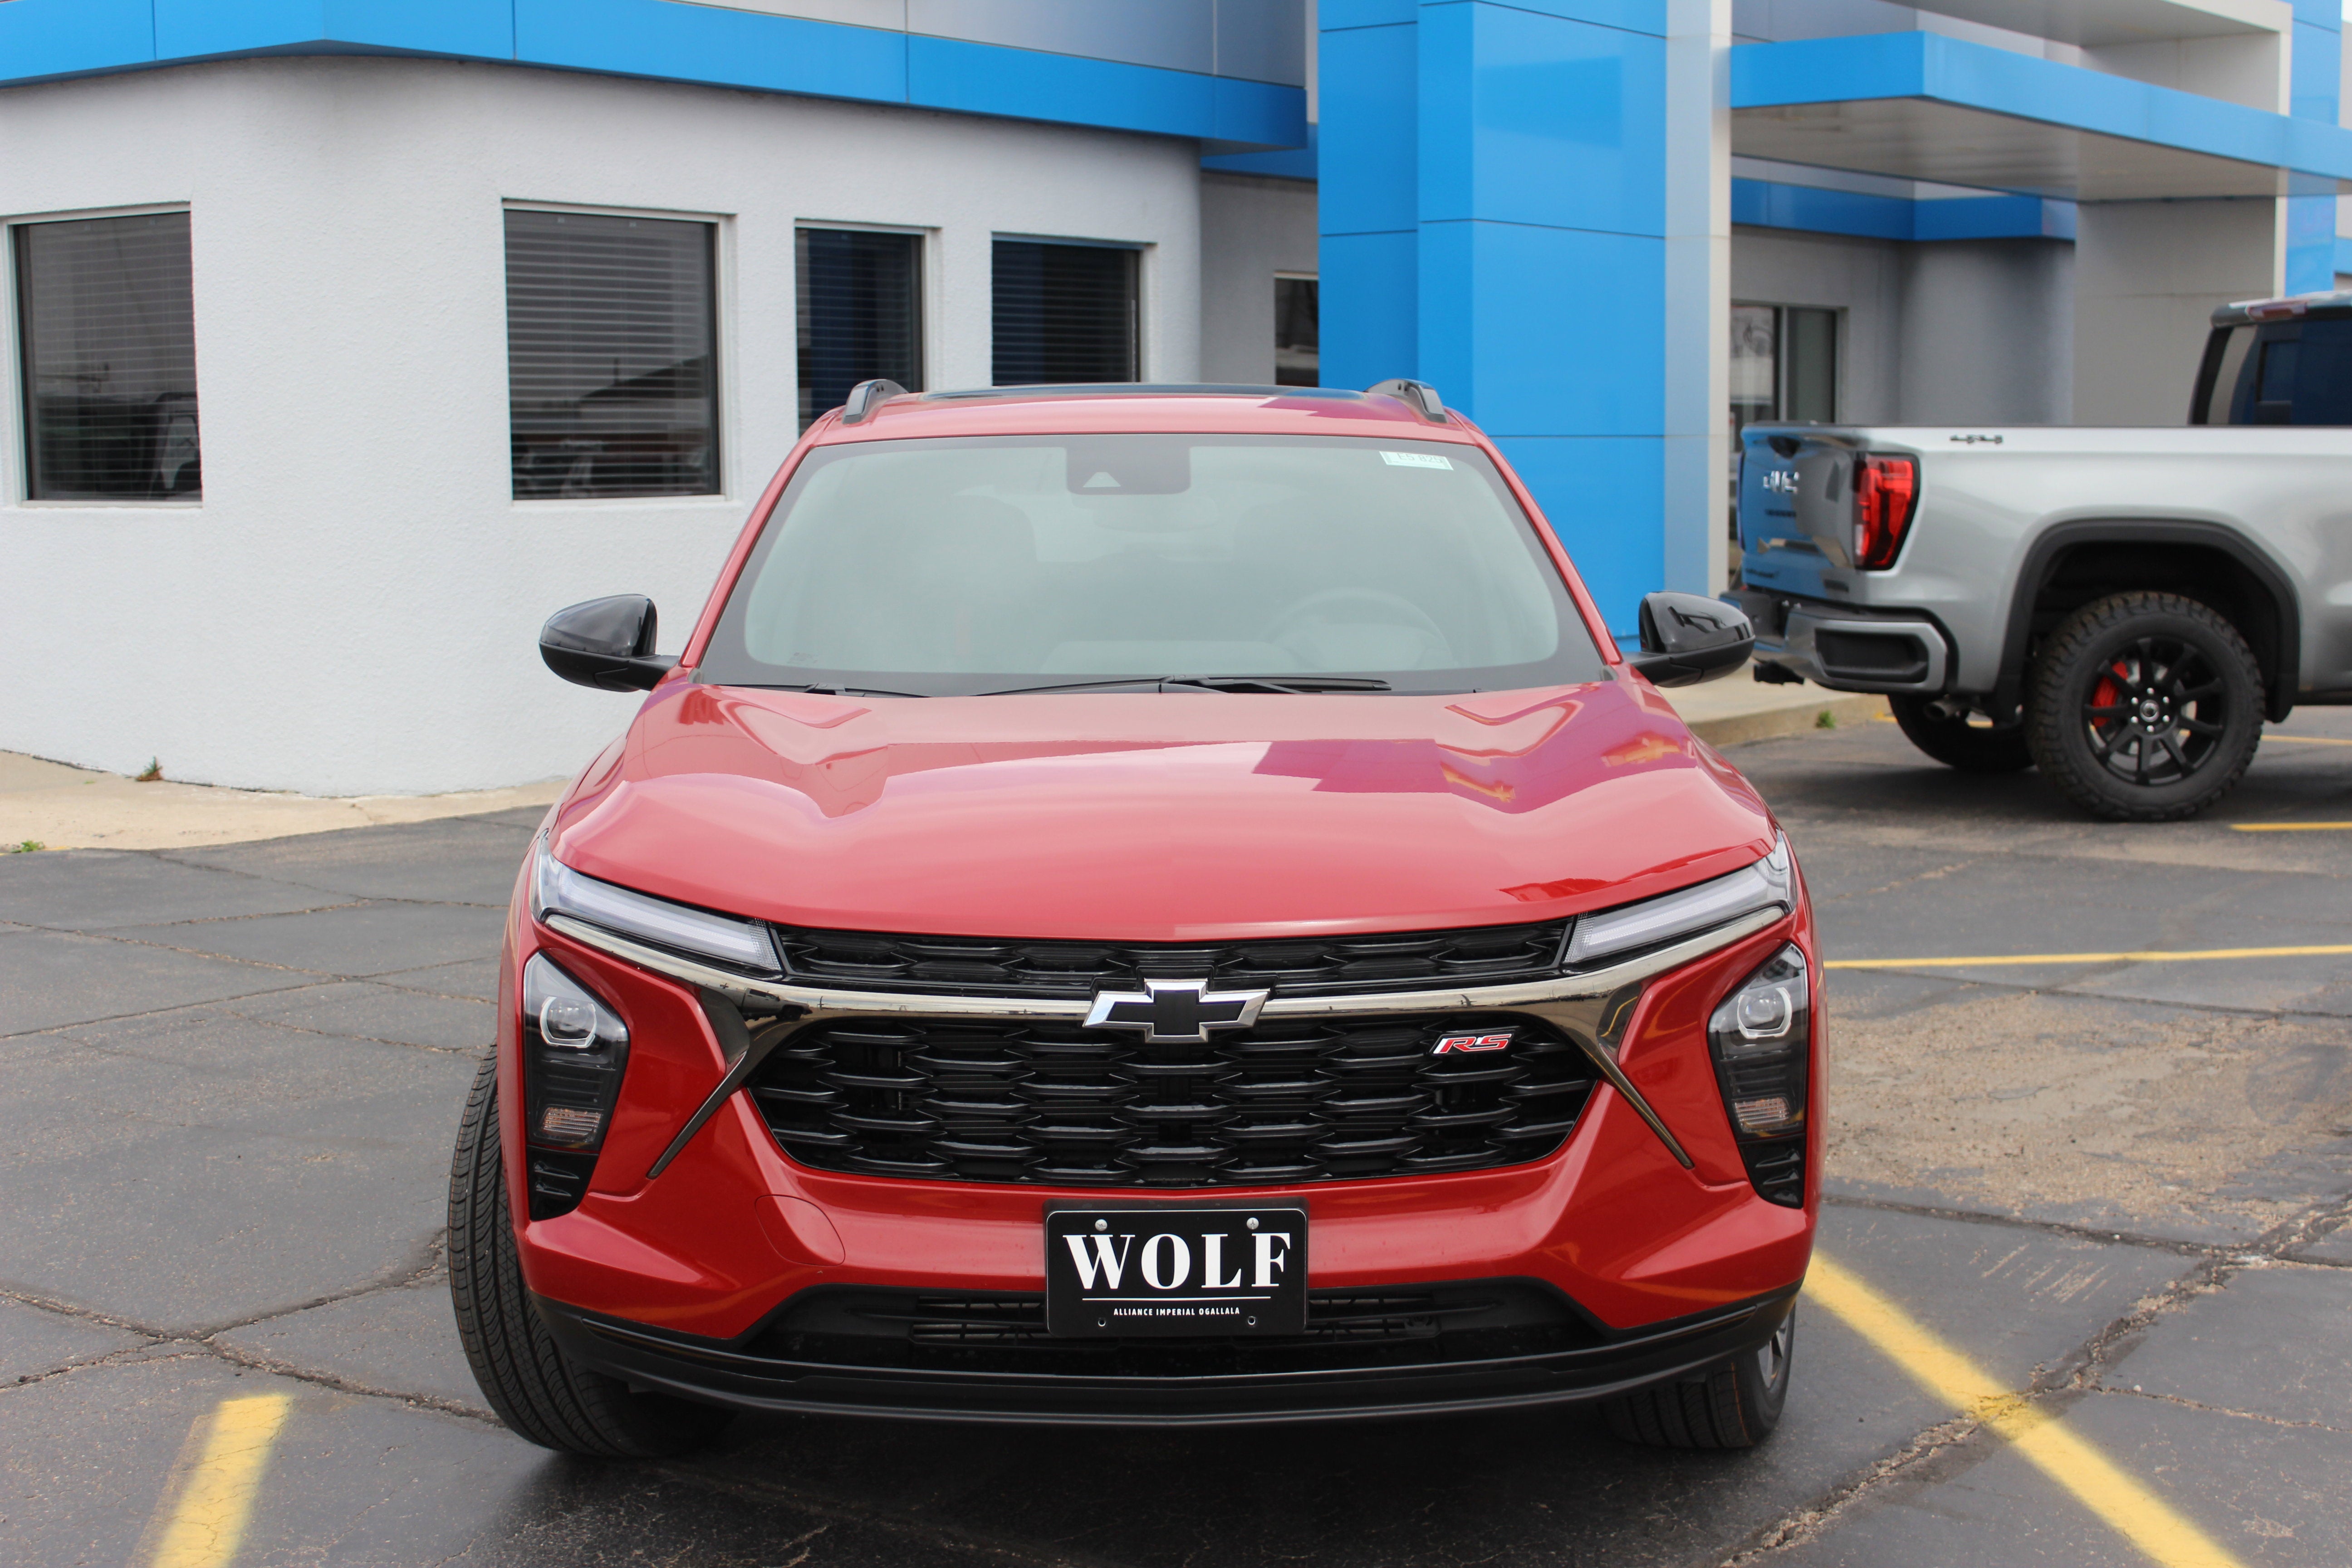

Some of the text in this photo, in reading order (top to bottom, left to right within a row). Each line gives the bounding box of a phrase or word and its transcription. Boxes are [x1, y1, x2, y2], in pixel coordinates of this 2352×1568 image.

[1433, 1034, 1512, 1054] RS
[1063, 1233, 1290, 1289] WOLF
[1199, 1307, 1240, 1315] OGALLALA
